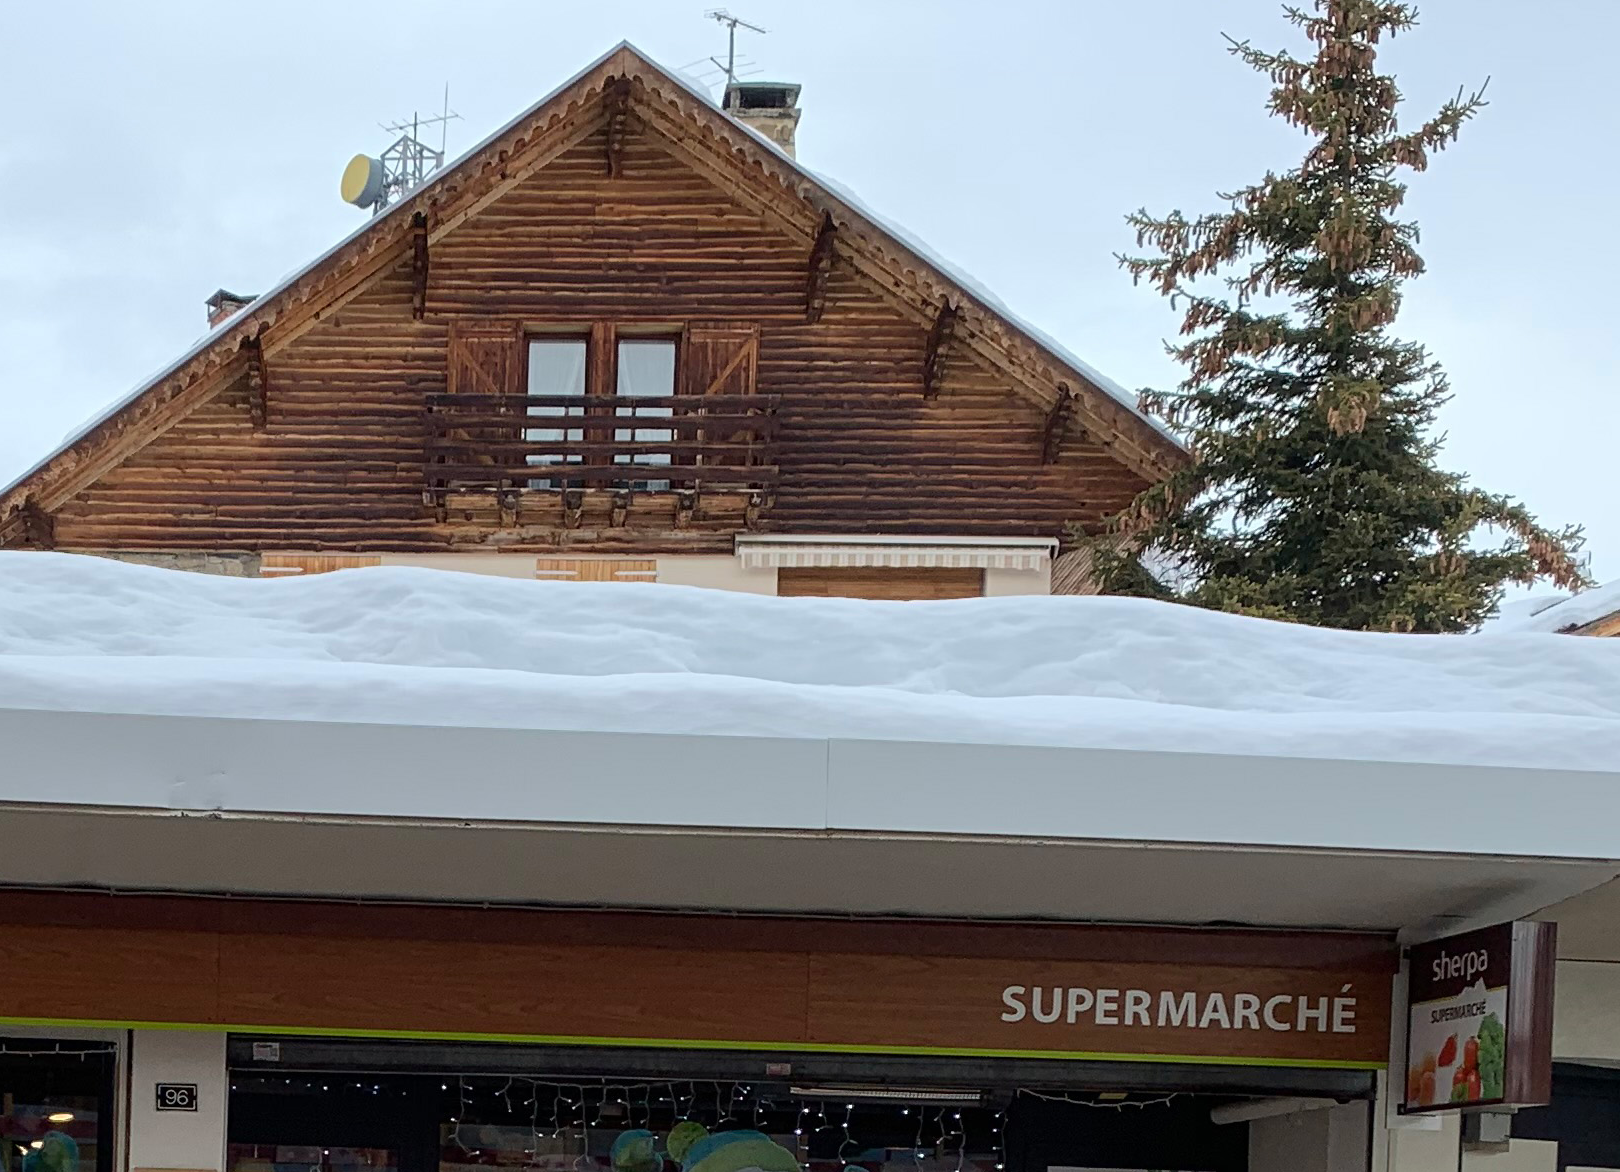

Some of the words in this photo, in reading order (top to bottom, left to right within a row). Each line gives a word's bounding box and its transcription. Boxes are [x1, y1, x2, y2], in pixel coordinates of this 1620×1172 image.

[1432, 949, 1489, 982] sherpa
[1001, 983, 1358, 1035] SUPERMARCHÉ
[1431, 998, 1487, 1024] SUPERMARCHÉ
[165, 1089, 189, 1105] 96
